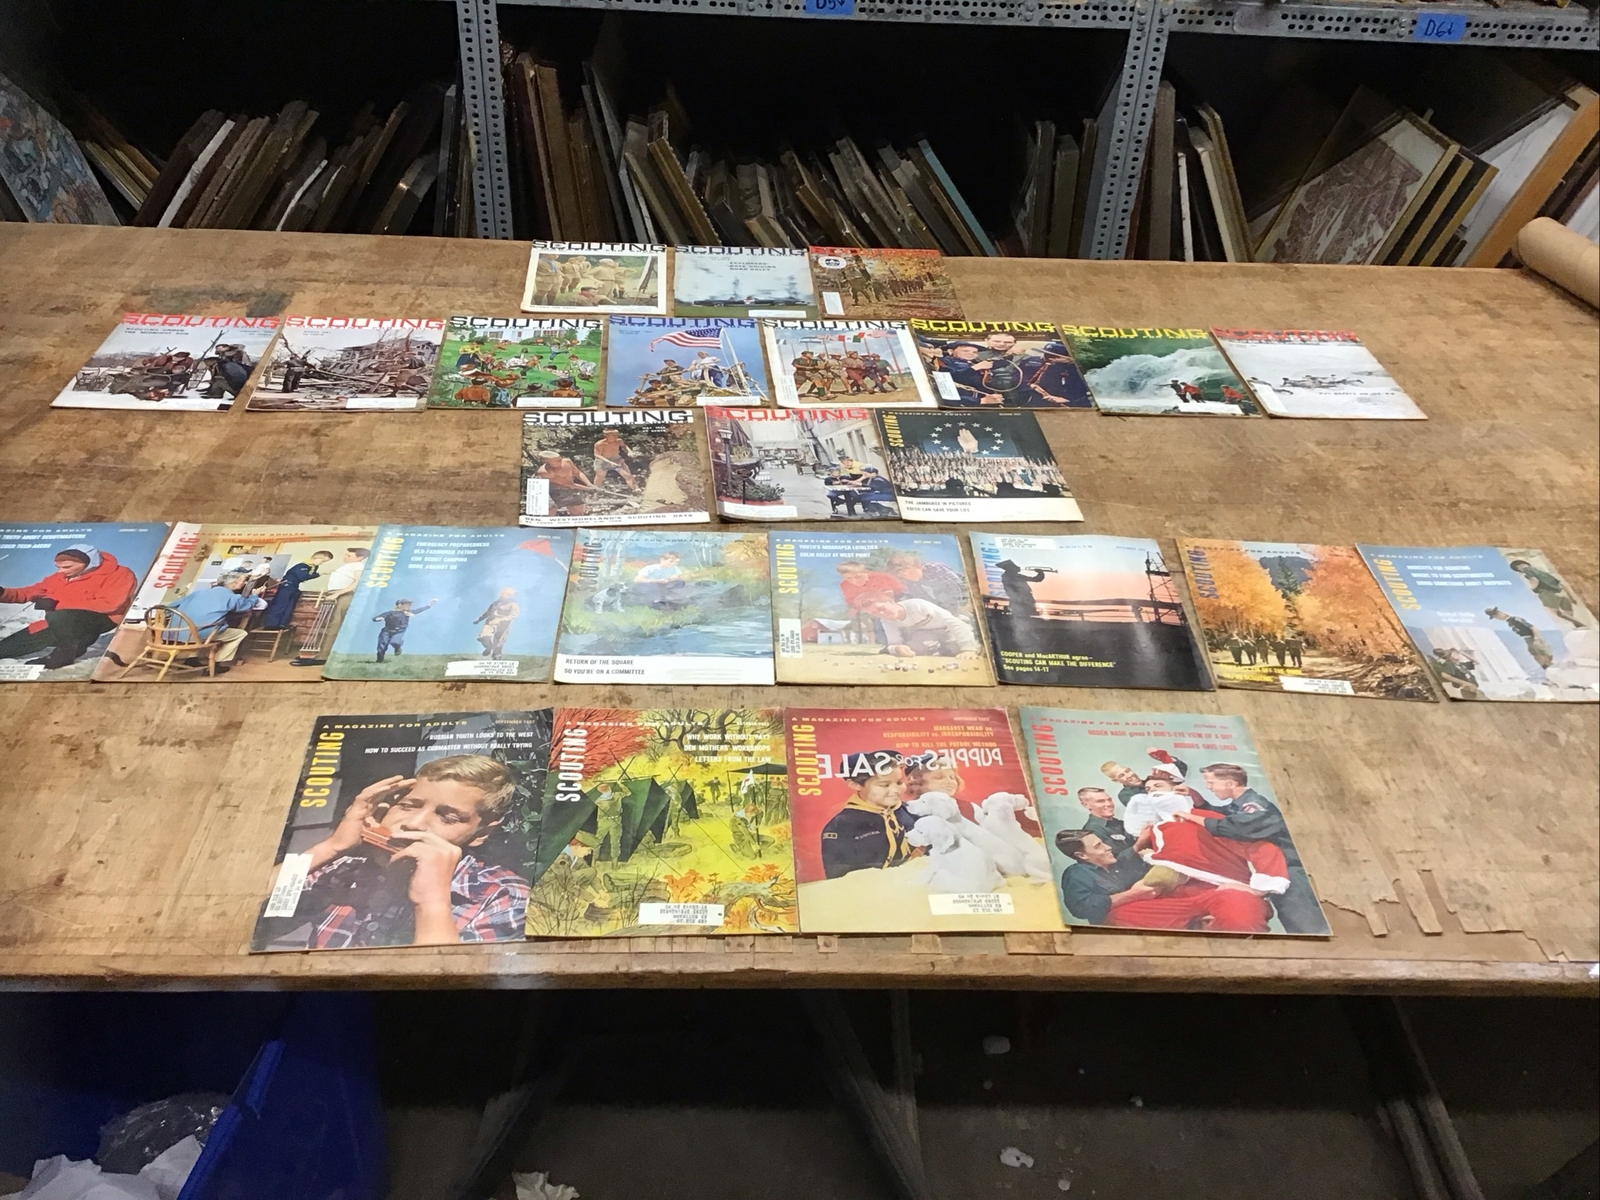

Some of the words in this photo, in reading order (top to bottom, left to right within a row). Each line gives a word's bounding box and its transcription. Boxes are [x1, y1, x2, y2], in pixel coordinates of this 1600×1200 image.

[533, 239, 666, 253] SCOUTING
[675, 245, 805, 256] SCOUTING
[122, 312, 281, 328] SCOUTING
[285, 315, 446, 329] SCOUTING
[450, 316, 603, 329] SCOUTING
[609, 315, 756, 328] SCOUTING
[763, 318, 908, 330] SCOUTING
[911, 318, 1056, 332] SCOUTING
[1061, 325, 1208, 338] SCOUTING
[523, 410, 689, 424] SCOUTING
[705, 406, 868, 420] SCOUTING
[882, 414, 905, 447] SCOUTING
[154, 537, 200, 589] SCOUTING
[366, 537, 405, 589] SCOUTING
[577, 542, 603, 592] SCOUTING
[776, 543, 800, 594] SCOUTING
[981, 547, 1007, 597] SCOUTING
[1187, 549, 1220, 599] SCOUTING
[1373, 558, 1421, 610] SCOUTING
[1034, 665, 1050, 673] 14-17
[1048, 659, 1066, 667] MAKE
[1040, 717, 1095, 725] MAGAZINE
[1188, 731, 1204, 739] VIEW
[427, 744, 462, 752] CUBMASTER
[556, 728, 588, 802] SCOUTING
[792, 725, 822, 796] SCOUTING
[1031, 723, 1068, 796] SCOUTING
[300, 732, 345, 808] SCOUTING
